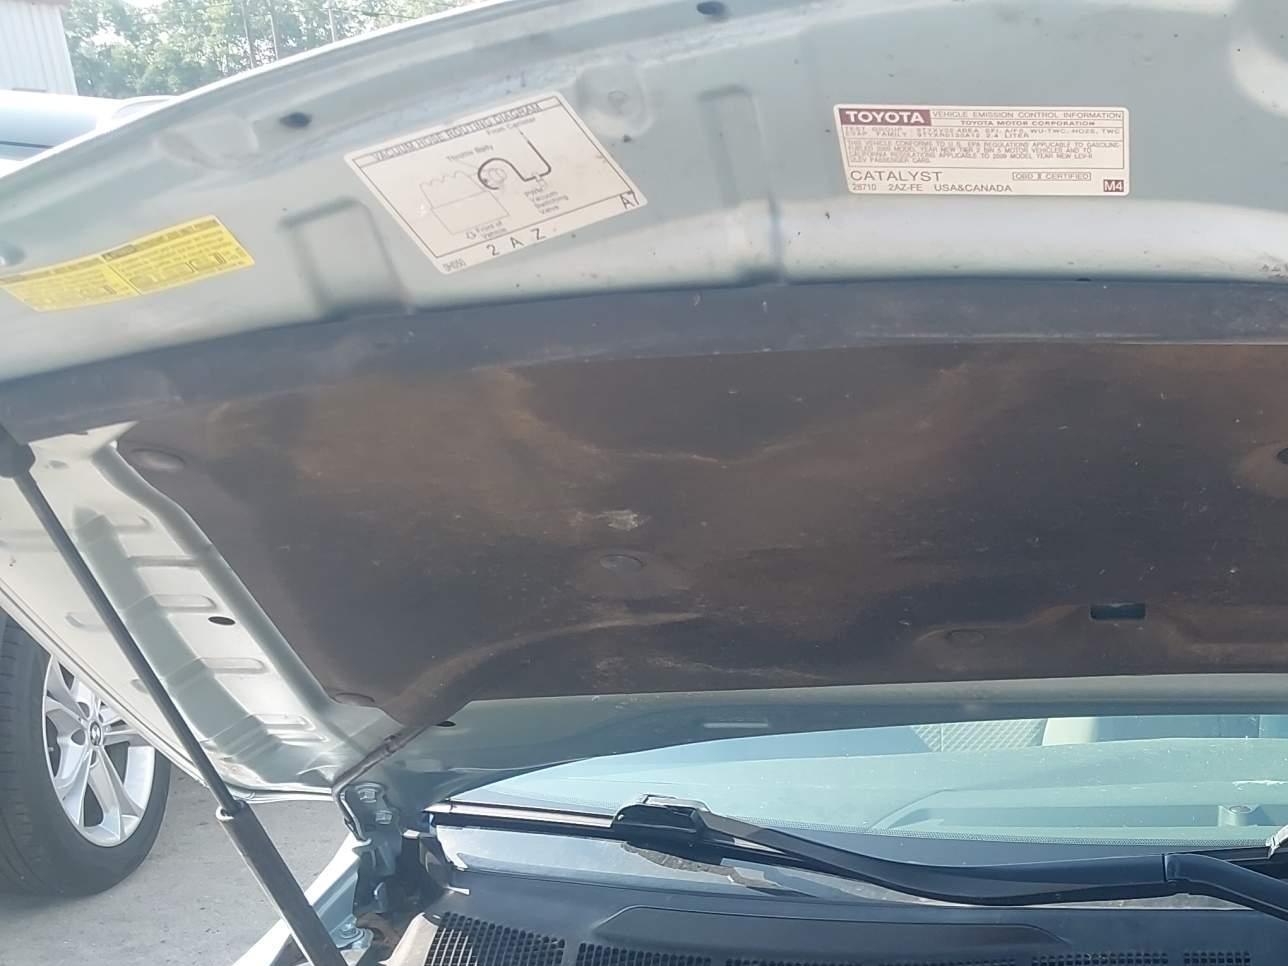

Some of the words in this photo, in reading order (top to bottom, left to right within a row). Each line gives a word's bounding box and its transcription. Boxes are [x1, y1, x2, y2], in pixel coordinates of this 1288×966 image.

[845, 111, 925, 124] TOYOTA
[850, 170, 943, 182] CATALYST
[888, 183, 923, 192] 2AZ-FE
[934, 184, 1013, 192] USA&CANADA
[1104, 181, 1123, 191] M4
[486, 244, 500, 256] 2
[510, 236, 524, 248] A
[530, 228, 546, 241] Z
